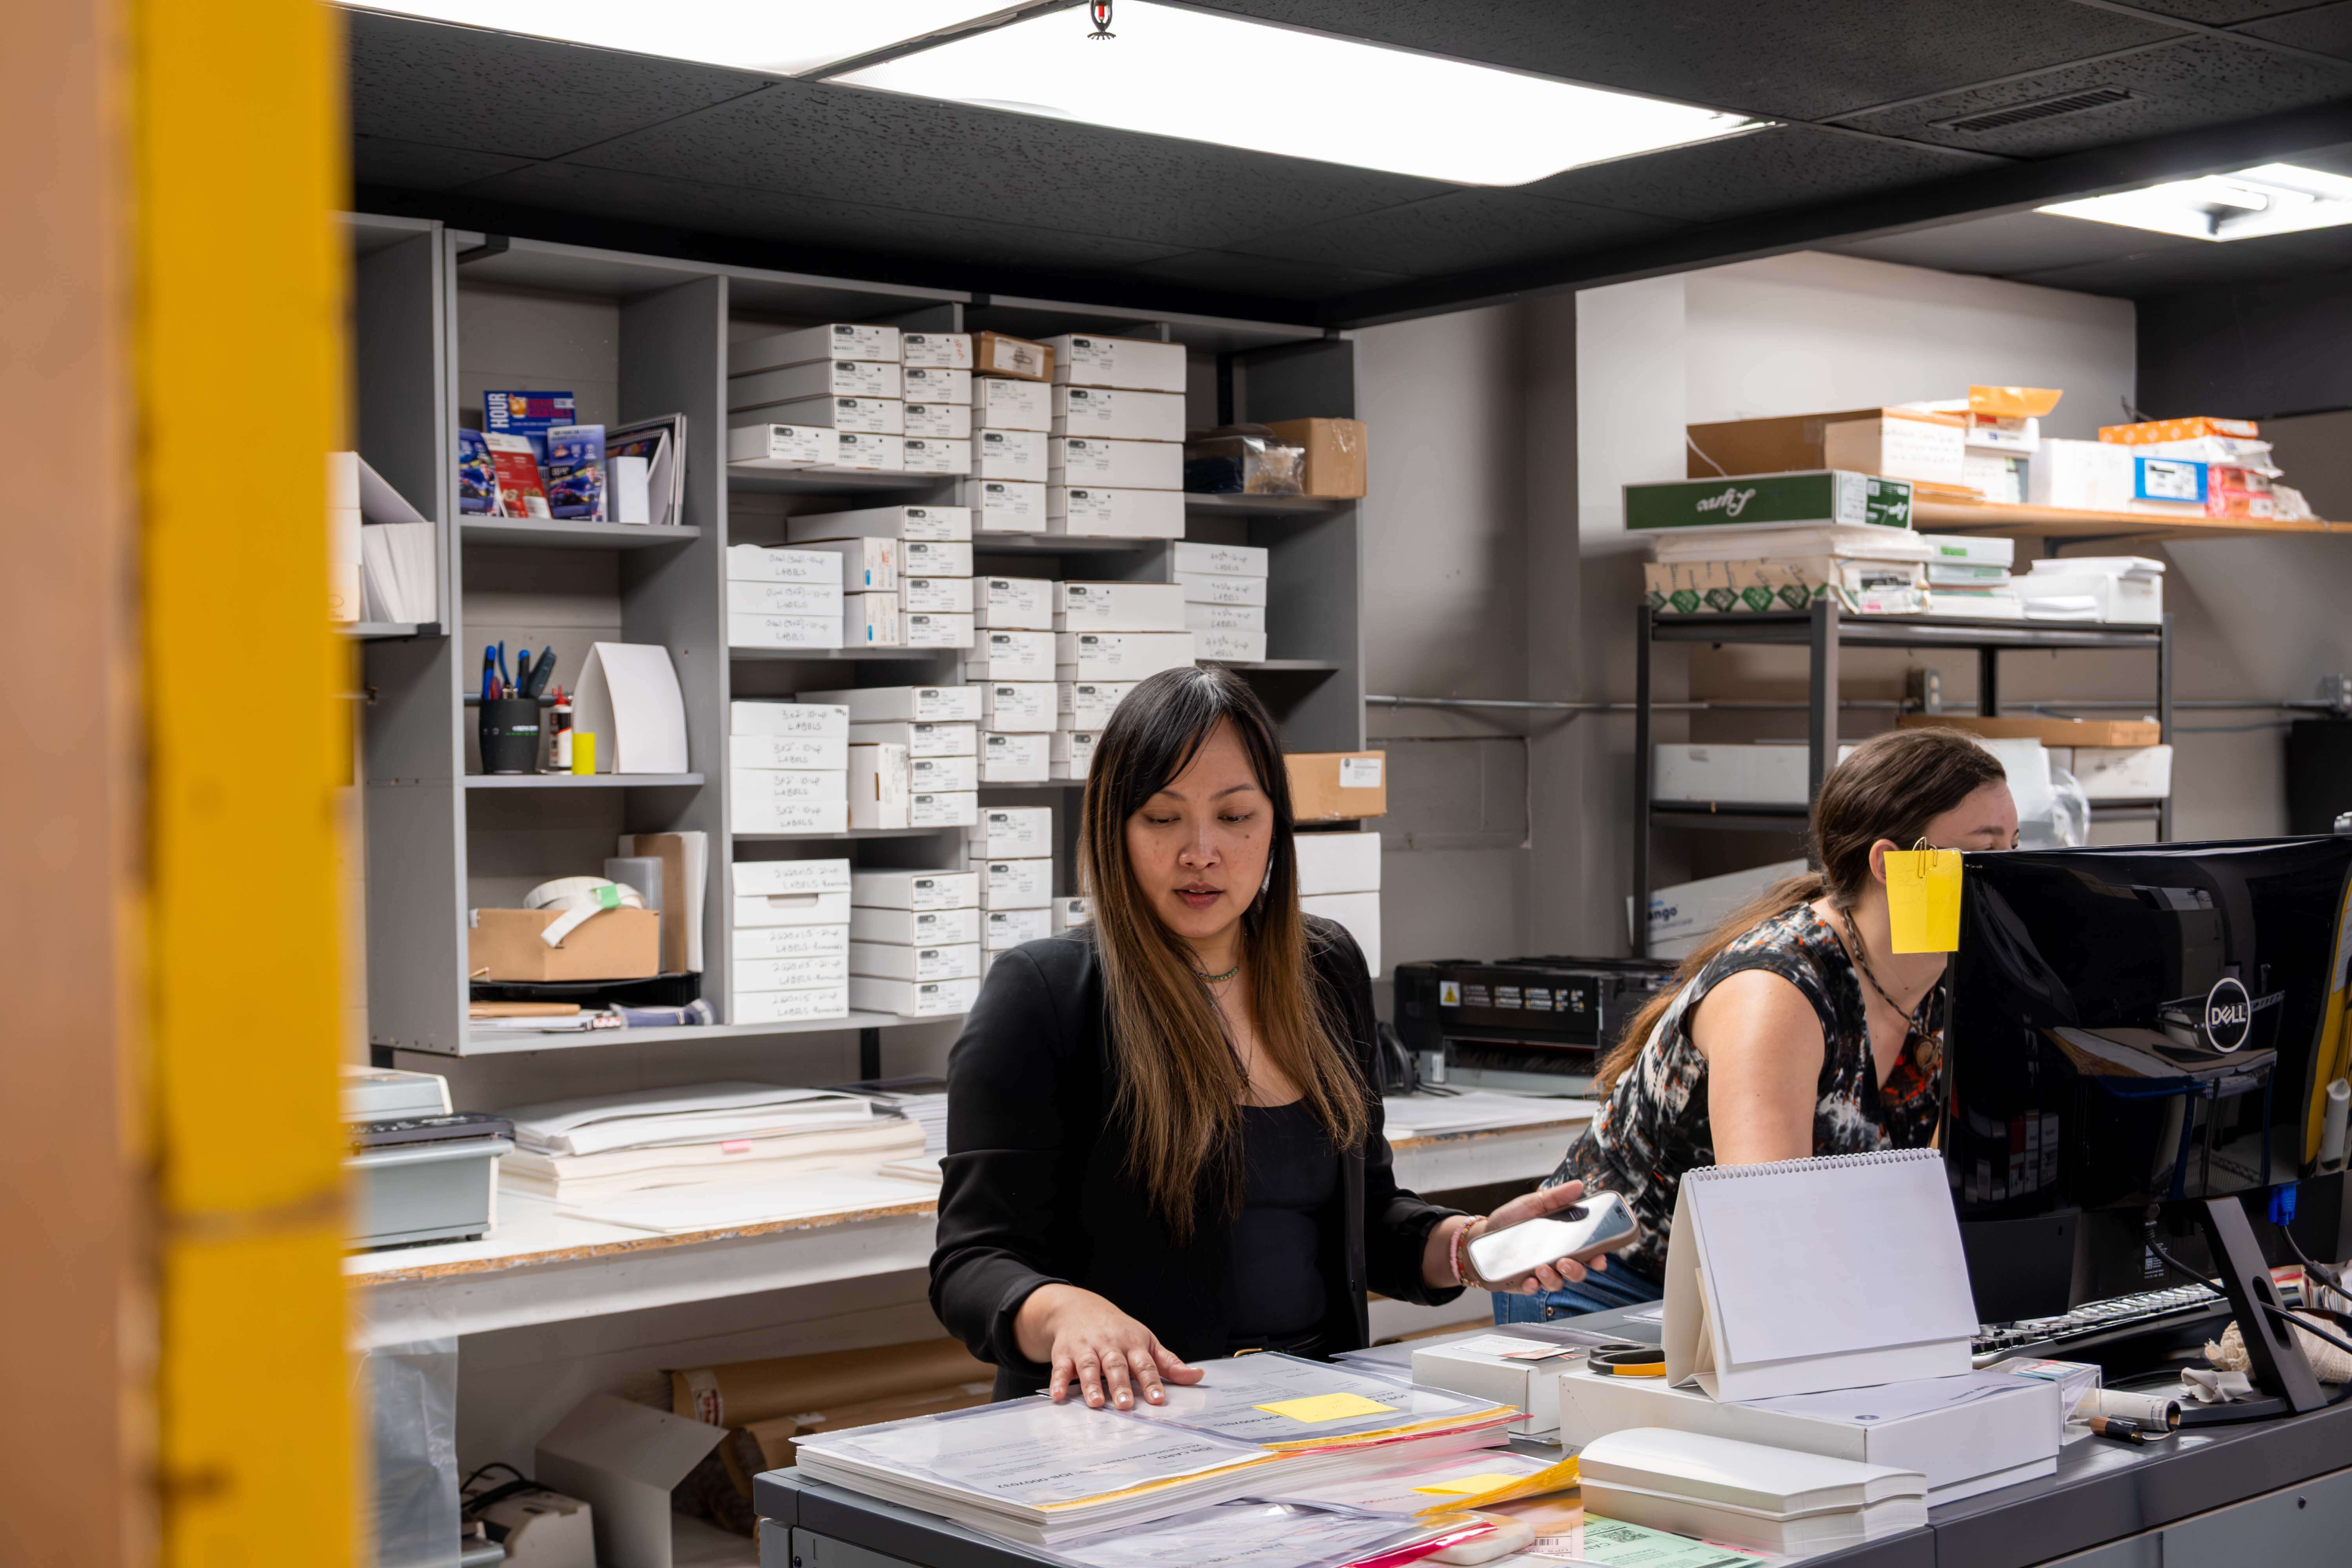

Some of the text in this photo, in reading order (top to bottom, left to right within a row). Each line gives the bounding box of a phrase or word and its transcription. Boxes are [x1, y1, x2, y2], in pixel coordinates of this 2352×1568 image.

[488, 393, 510, 428] HOUR
[775, 568, 806, 576] LABELS
[777, 600, 808, 609] LABELS
[776, 632, 806, 641] LABELS
[788, 722, 822, 731] LABELS
[777, 755, 808, 764] LABELS
[774, 788, 809, 797] LABELS
[780, 819, 814, 828] LABELS
[2211, 1004, 2246, 1026] DELL
[1148, 1448, 1180, 1456] DESIGN
[1157, 1450, 1190, 1460] CARD
[995, 1472, 1073, 1489] JOB-0007032
